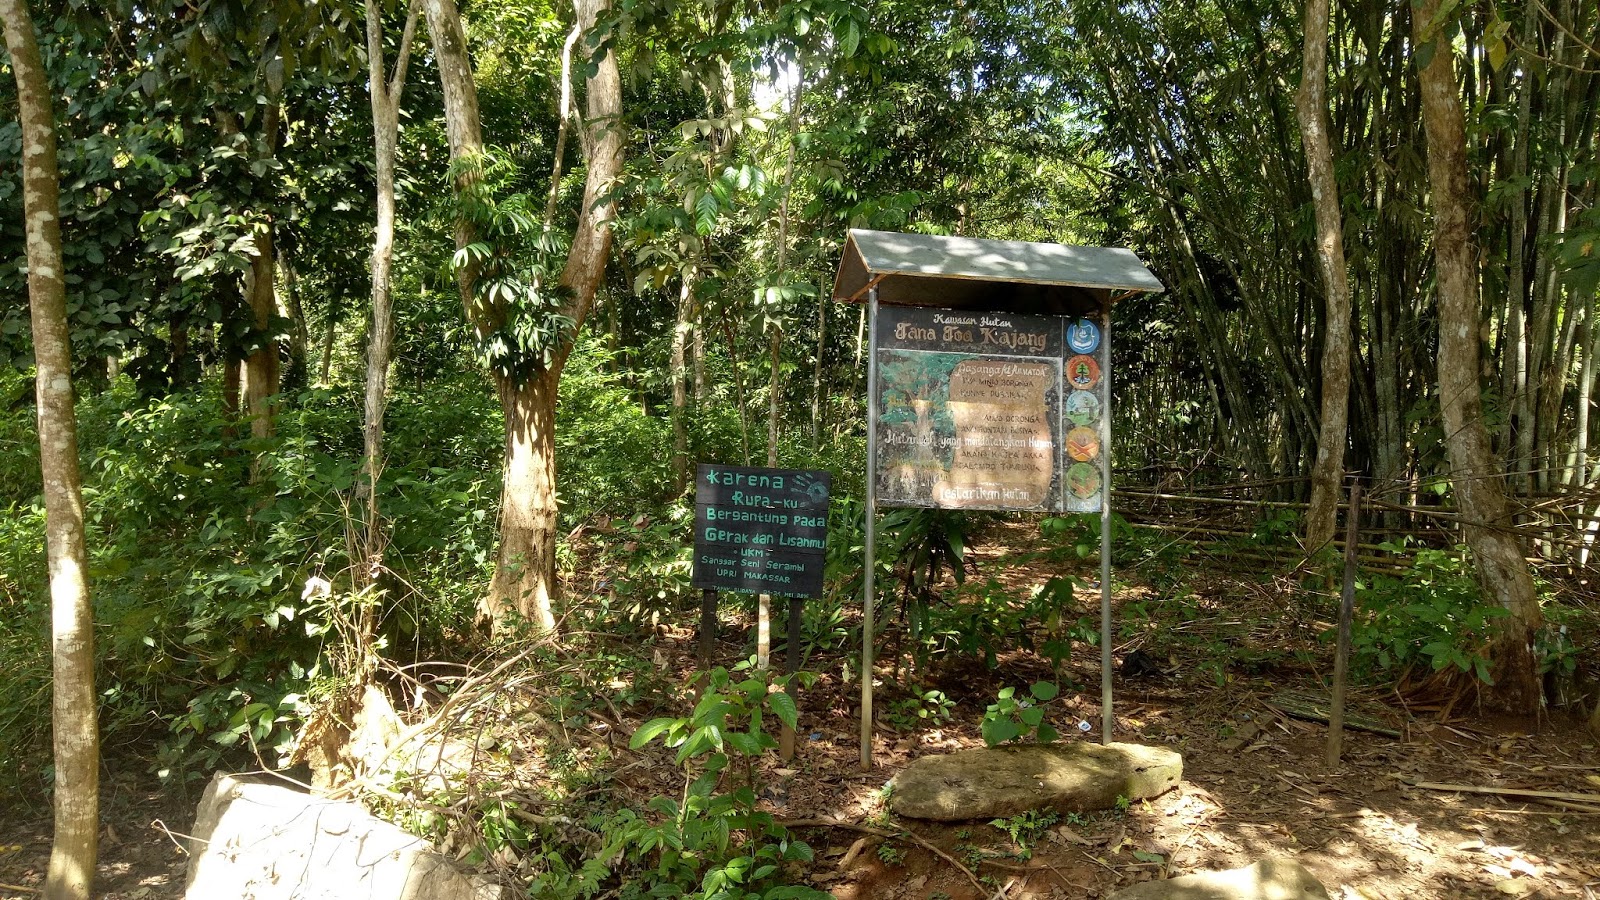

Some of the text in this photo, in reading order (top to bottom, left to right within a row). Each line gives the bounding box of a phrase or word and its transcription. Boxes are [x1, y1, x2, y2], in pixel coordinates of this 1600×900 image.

[933, 313, 1013, 328] Kawasan Hutan
[895, 322, 1048, 352] Tana Toa Kajang
[939, 436, 961, 450] yang
[706, 507, 788, 525] Bergantung
[705, 527, 825, 549] Gerak dan Lisanmu
[741, 548, 764, 558] UKM
[701, 556, 805, 572] Sanggar Seni Serambi
[716, 568, 791, 584] UPRI MAKASSAR
